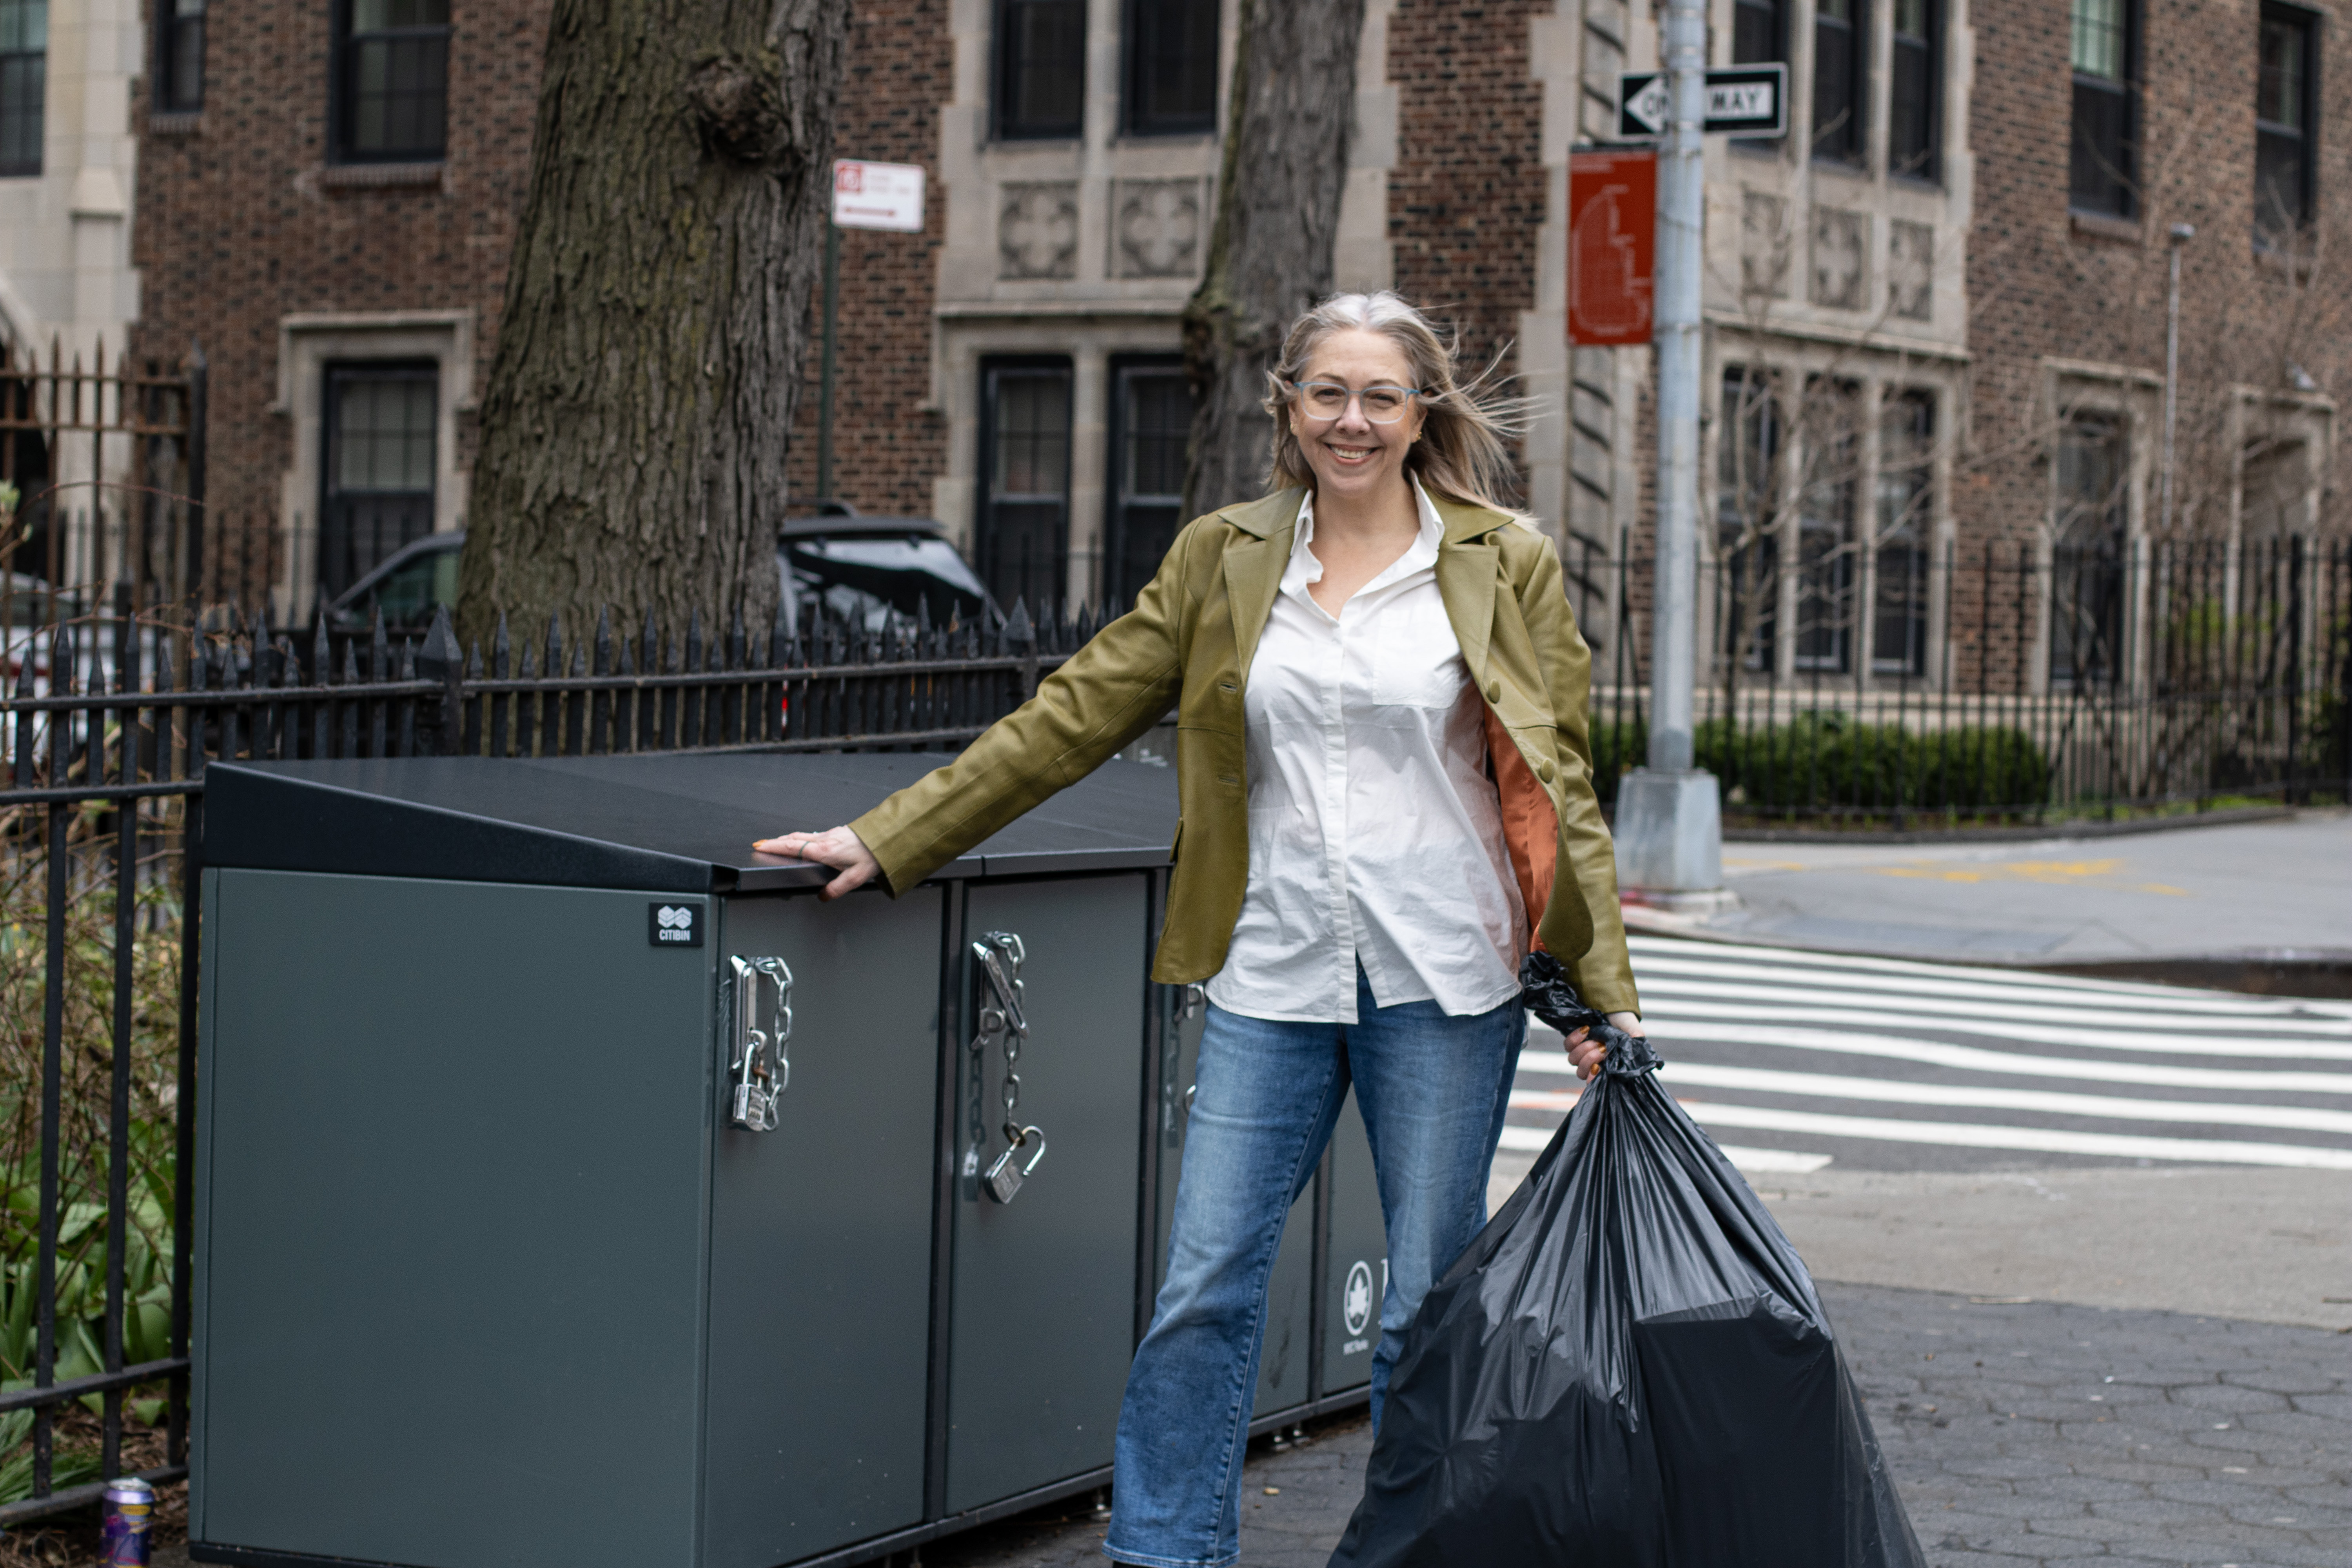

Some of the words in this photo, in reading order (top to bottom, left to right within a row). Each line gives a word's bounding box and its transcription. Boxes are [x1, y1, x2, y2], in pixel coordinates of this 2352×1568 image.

[1643, 93, 1668, 116] ON
[1710, 89, 1761, 112] WAY
[659, 929, 690, 941] CITIBIN
